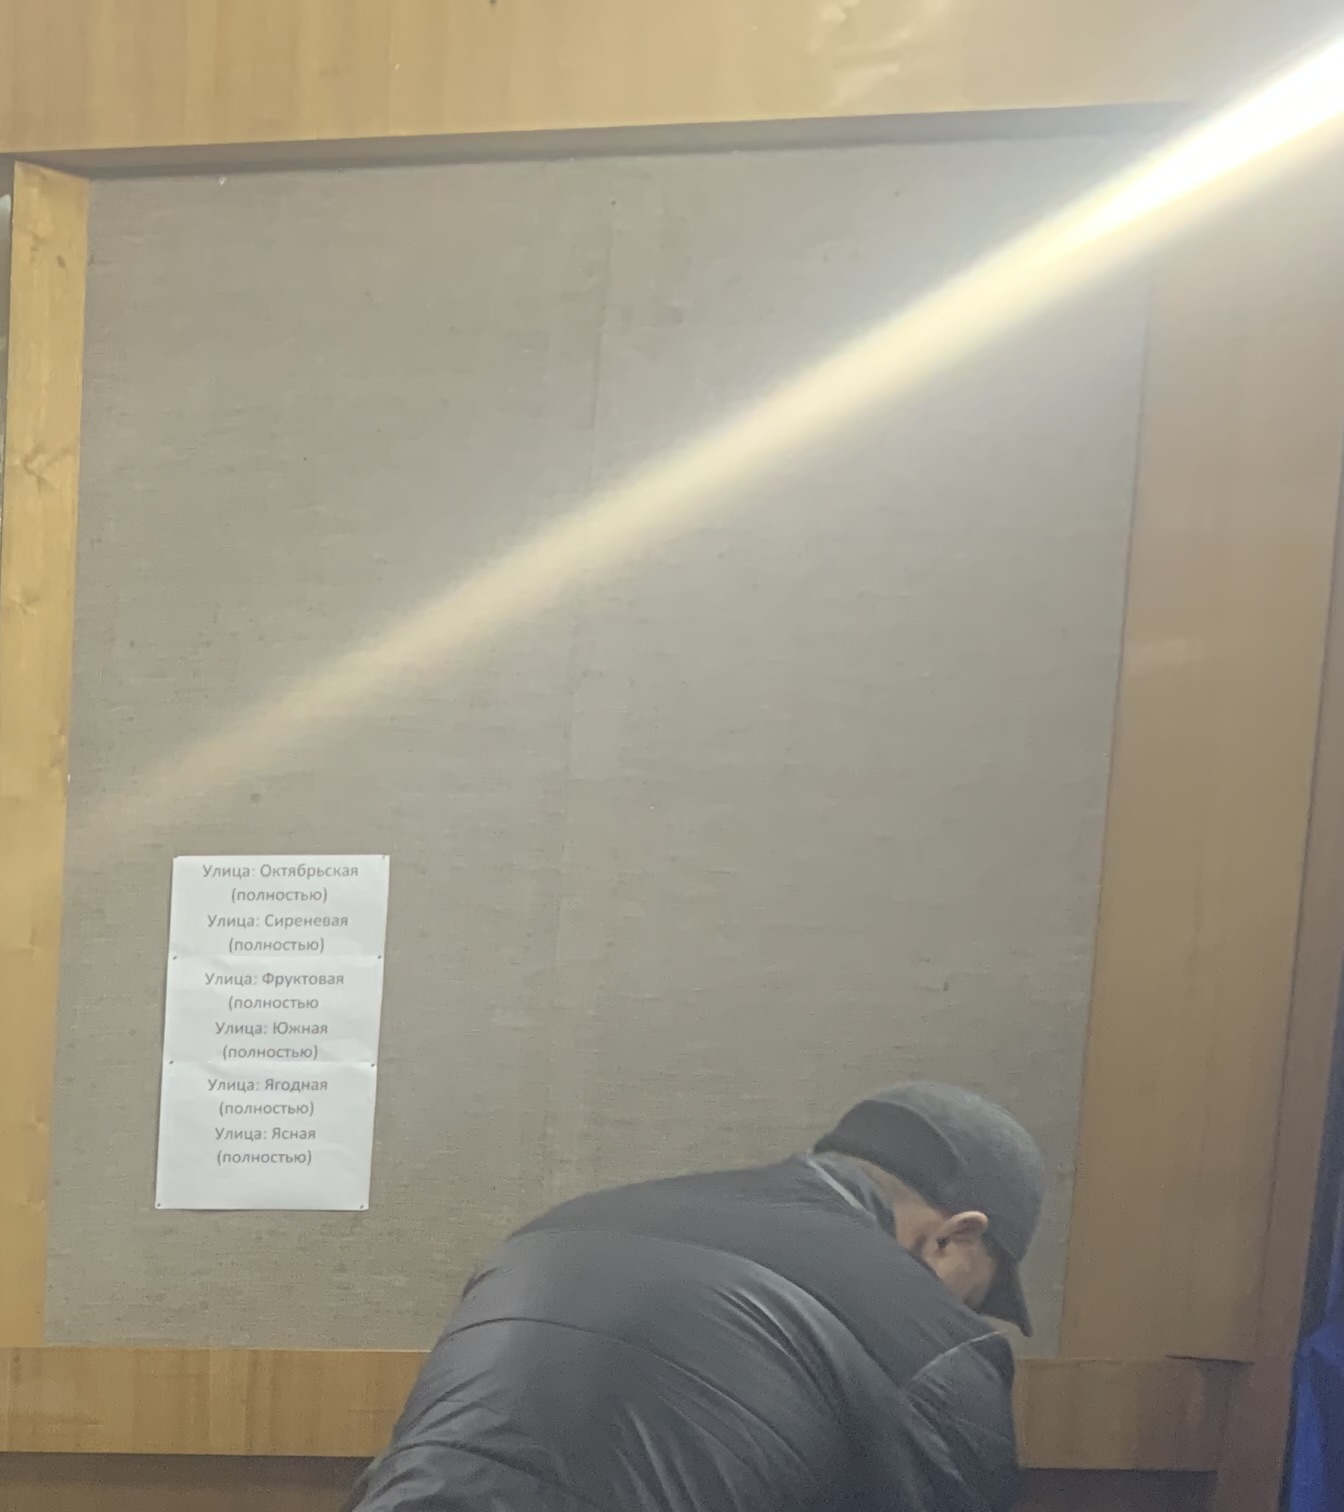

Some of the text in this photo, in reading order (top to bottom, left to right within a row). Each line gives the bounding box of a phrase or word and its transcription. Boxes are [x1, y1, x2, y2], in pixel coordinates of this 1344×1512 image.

[202, 863, 358, 880] Улица: Октябрьская
[231, 887, 328, 904] (полностью)
[207, 914, 348, 929] Улица: Сиреневая
[229, 937, 324, 954] (полностью)
[205, 972, 344, 988] Улица: Фруктовая
[228, 995, 319, 1011] (полностью
[215, 1021, 328, 1037] Улица: Южная
[222, 1045, 318, 1061] (полностью)
[208, 1077, 328, 1093] Улица: Ягодная
[219, 1101, 314, 1117] (полностью)
[215, 1127, 316, 1142] Улица: Ясная
[217, 1150, 312, 1166] (полностью)
